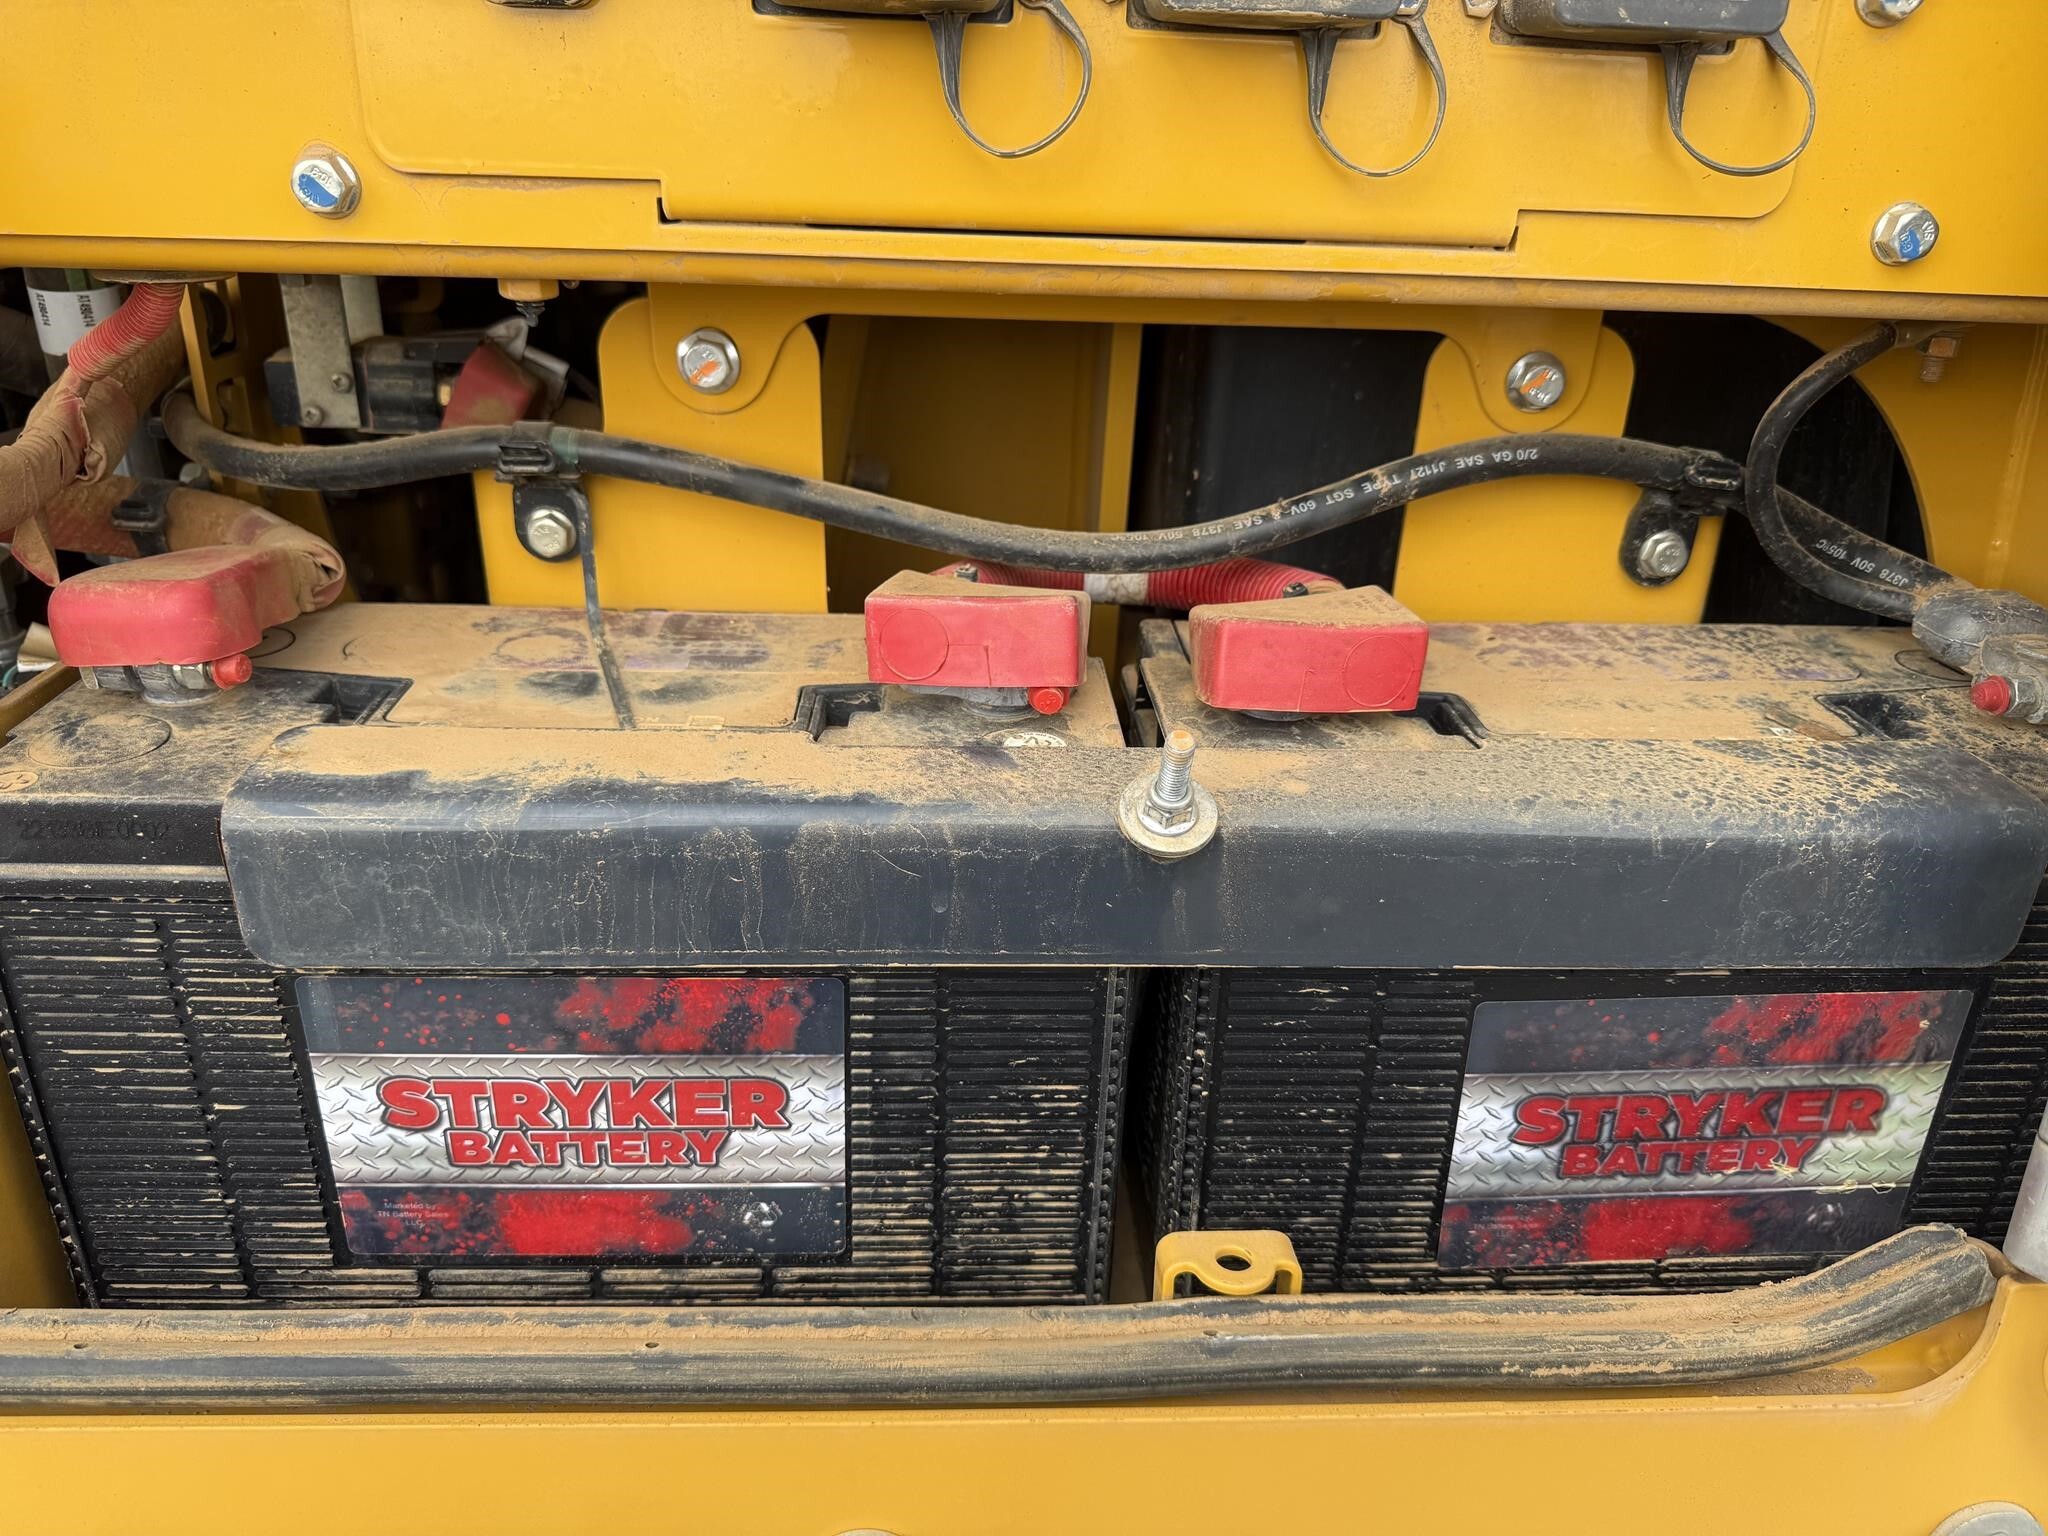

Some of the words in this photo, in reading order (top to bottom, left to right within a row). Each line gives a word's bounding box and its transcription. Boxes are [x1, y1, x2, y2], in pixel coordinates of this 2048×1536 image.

[1454, 454, 1485, 469] SAE
[1491, 450, 1512, 463] GA
[1516, 448, 1539, 460] 2/0
[1409, 461, 1448, 481] J1127
[1360, 473, 1402, 494] TYPE
[1325, 487, 1355, 505] SGT
[1290, 500, 1317, 516] 60V
[1191, 524, 1225, 537] J378
[1233, 514, 1263, 530] SAE
[1849, 557, 1876, 573] 50V
[1878, 568, 1909, 587] J378
[378, 1076, 791, 1131] STRYKER
[1511, 1085, 1889, 1145] STRYKER
[447, 1129, 730, 1167] BATTERY
[1559, 1136, 1819, 1178] BATTERY
[392, 1210, 423, 1218] Battery
